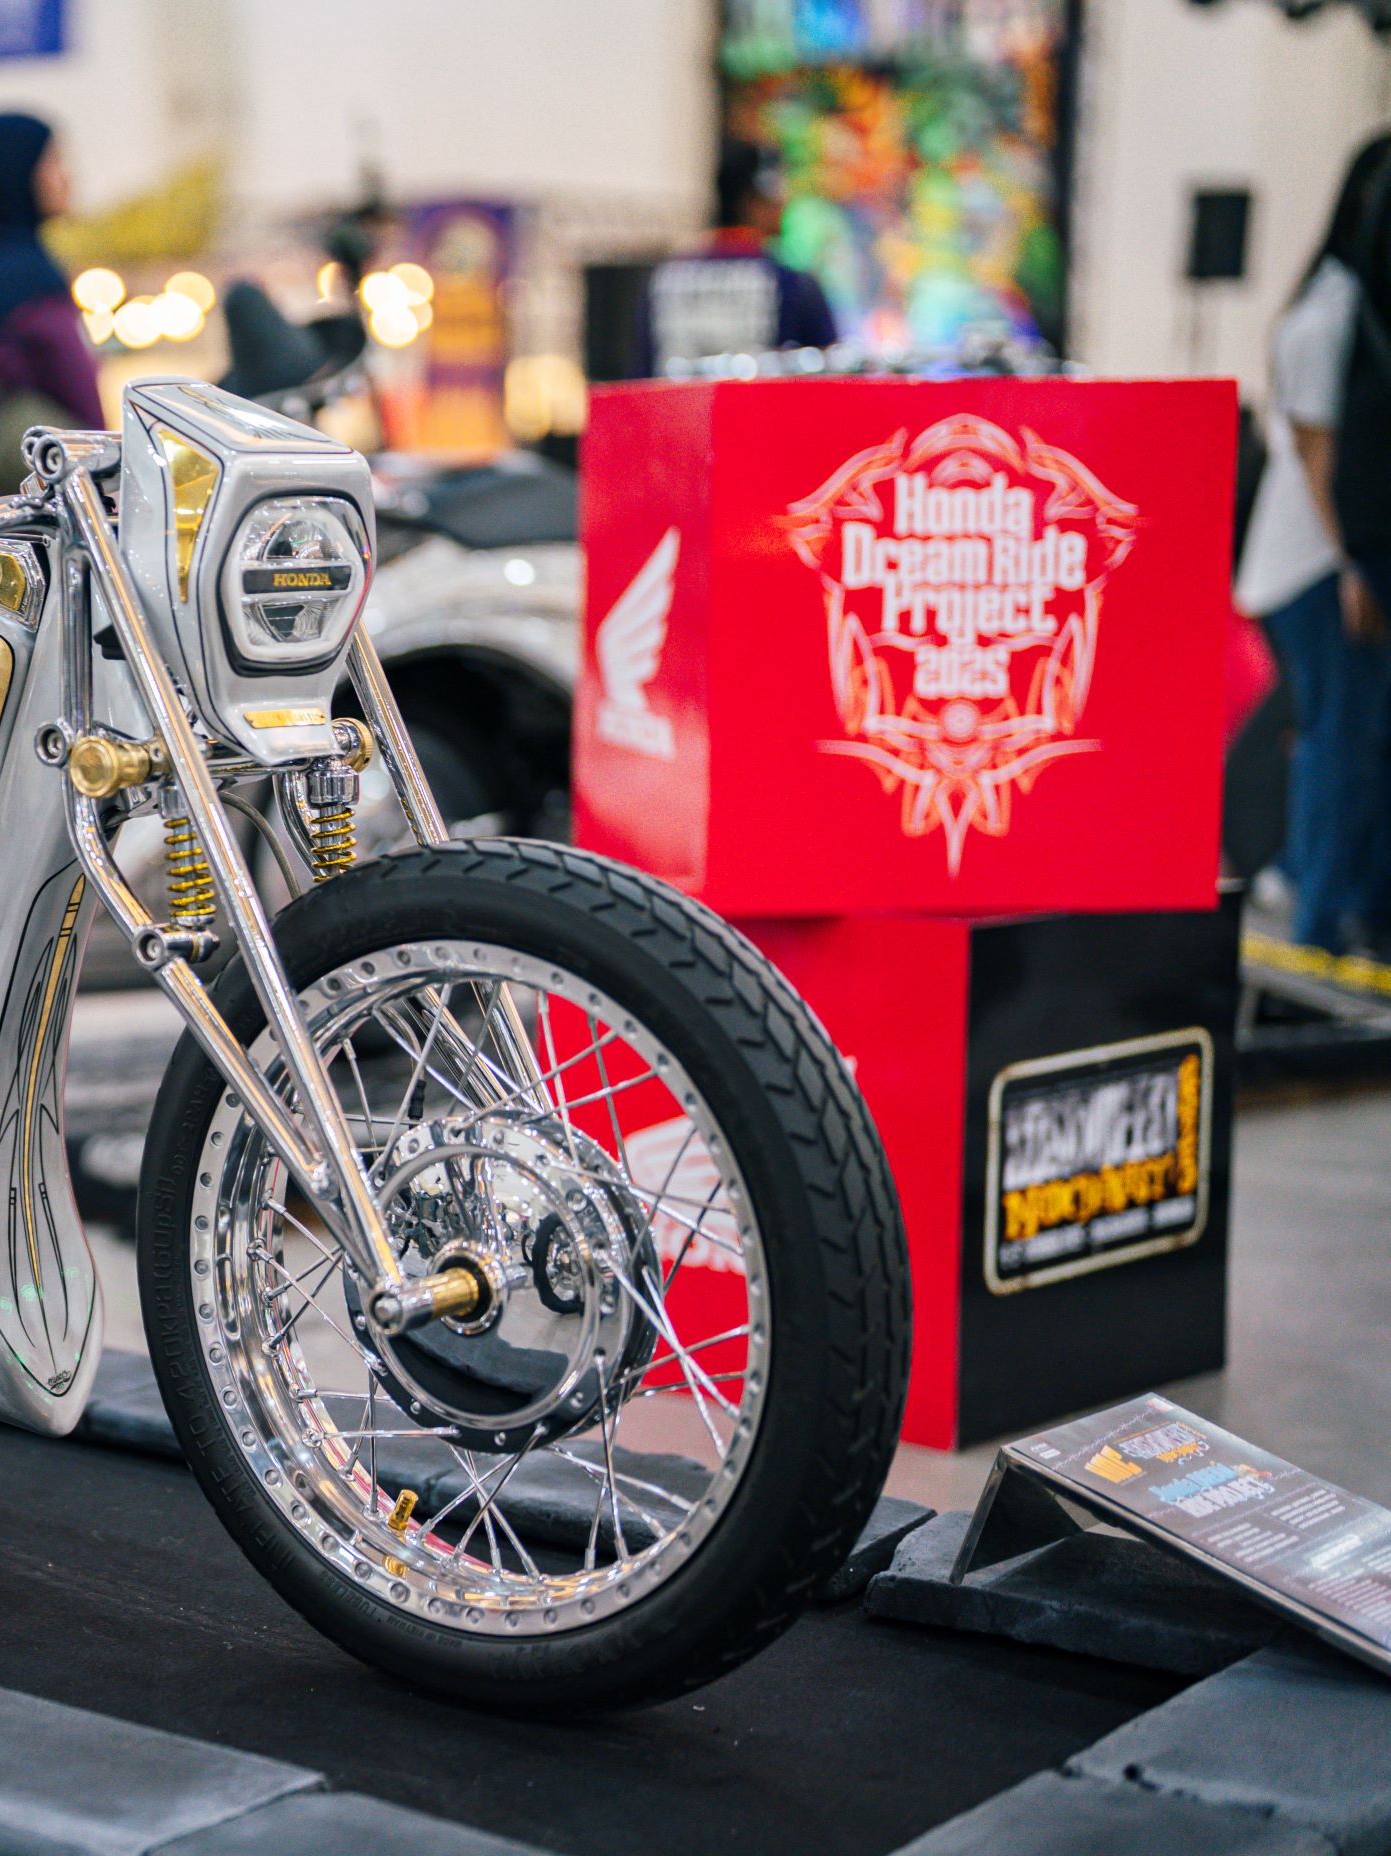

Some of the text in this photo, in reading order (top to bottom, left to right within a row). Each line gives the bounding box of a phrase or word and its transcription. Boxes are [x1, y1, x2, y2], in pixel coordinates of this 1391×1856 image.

[893, 471, 1034, 538] Honda
[273, 573, 331, 587] HONDA
[842, 520, 1087, 590] Dream Ride
[882, 578, 1058, 645] Project
[915, 645, 1009, 699] 2025
